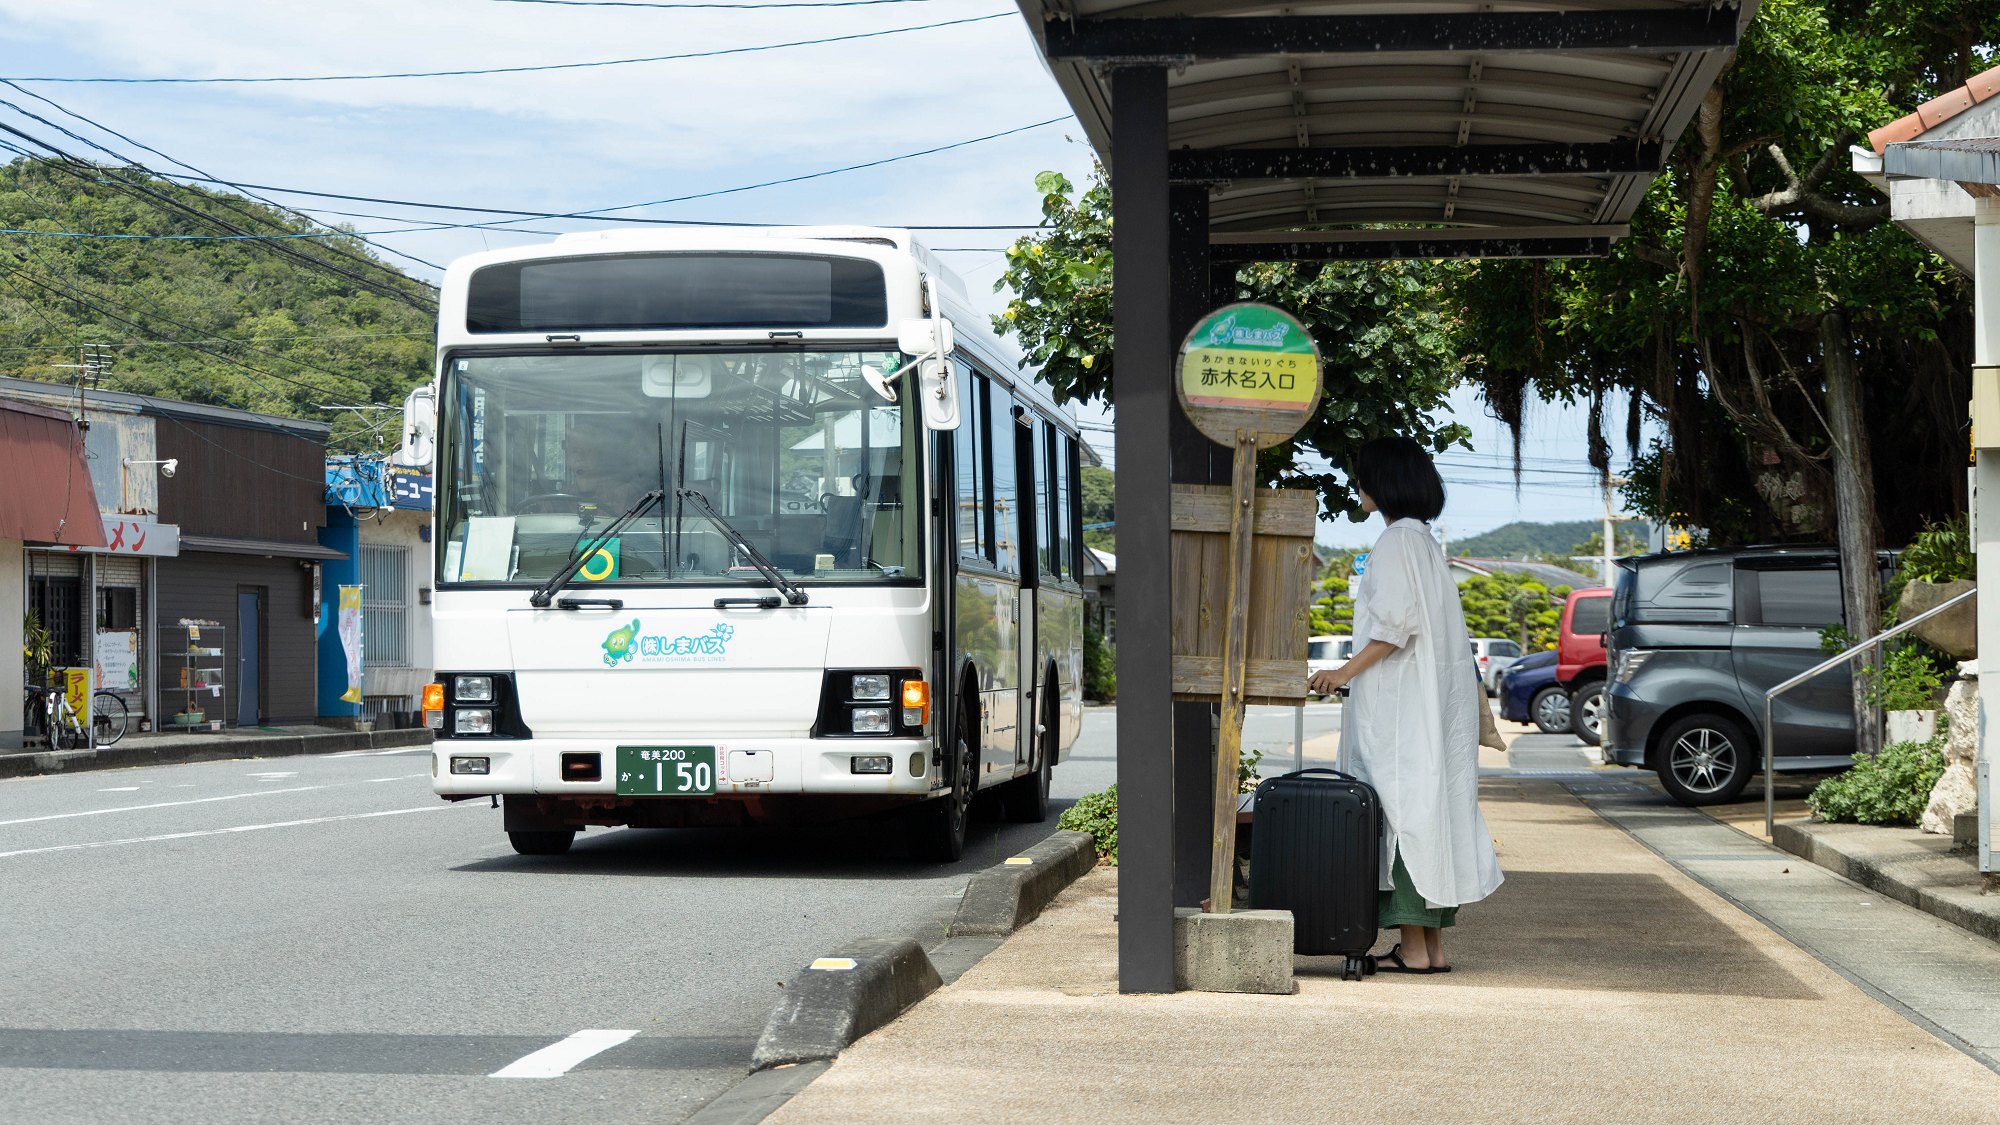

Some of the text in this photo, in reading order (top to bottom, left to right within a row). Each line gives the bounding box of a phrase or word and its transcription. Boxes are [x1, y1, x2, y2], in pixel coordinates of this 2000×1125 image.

[1202, 354, 1296, 368] あかきないりぐち
[1201, 367, 1295, 390] 赤木名入口
[70, 672, 85, 715] ラーメン
[621, 771, 632, 782] か
